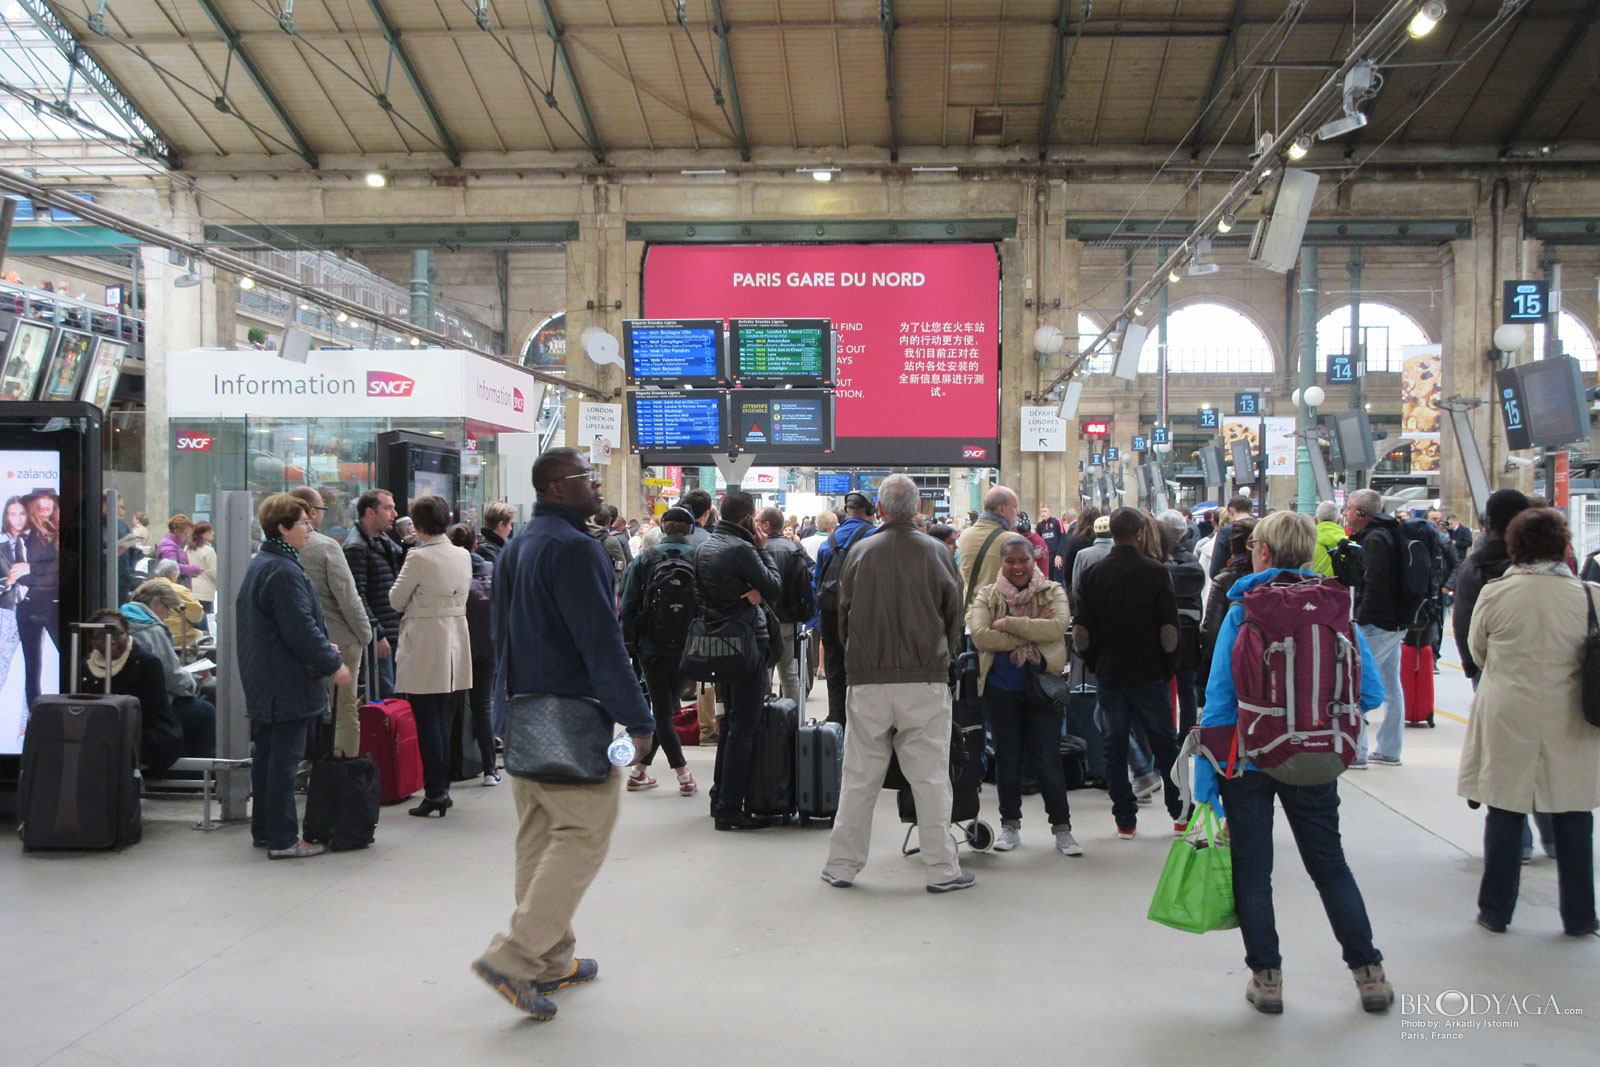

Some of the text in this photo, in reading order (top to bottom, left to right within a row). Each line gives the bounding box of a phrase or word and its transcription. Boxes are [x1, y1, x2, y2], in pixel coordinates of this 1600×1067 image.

[733, 272, 925, 287] PARIS GARE DU NORD
[1513, 295, 1540, 314] 15
[840, 323, 863, 331] FIND
[899, 322, 985, 333] 为了让您在火车站
[846, 345, 866, 353] OUT
[904, 348, 980, 359] 我们目前正对在
[904, 361, 979, 372] 站内各处安装的
[1332, 364, 1351, 379] 14
[213, 374, 413, 395] Information SNCF
[898, 373, 985, 385] 全新信息屏进行测
[476, 378, 524, 411] Information SNCF
[930, 386, 946, 397] 试。
[1239, 401, 1254, 411] 13
[1505, 400, 1520, 424] 15
[1201, 415, 1215, 425] 12
[1037, 426, 1059, 434] ÉTAGE
[1154, 433, 1165, 441] 11
[177, 438, 210, 449] SNCF
[466, 439, 477, 451] SNCF
[963, 450, 985, 458] SNCF
[17, 468, 59, 480] zalando
